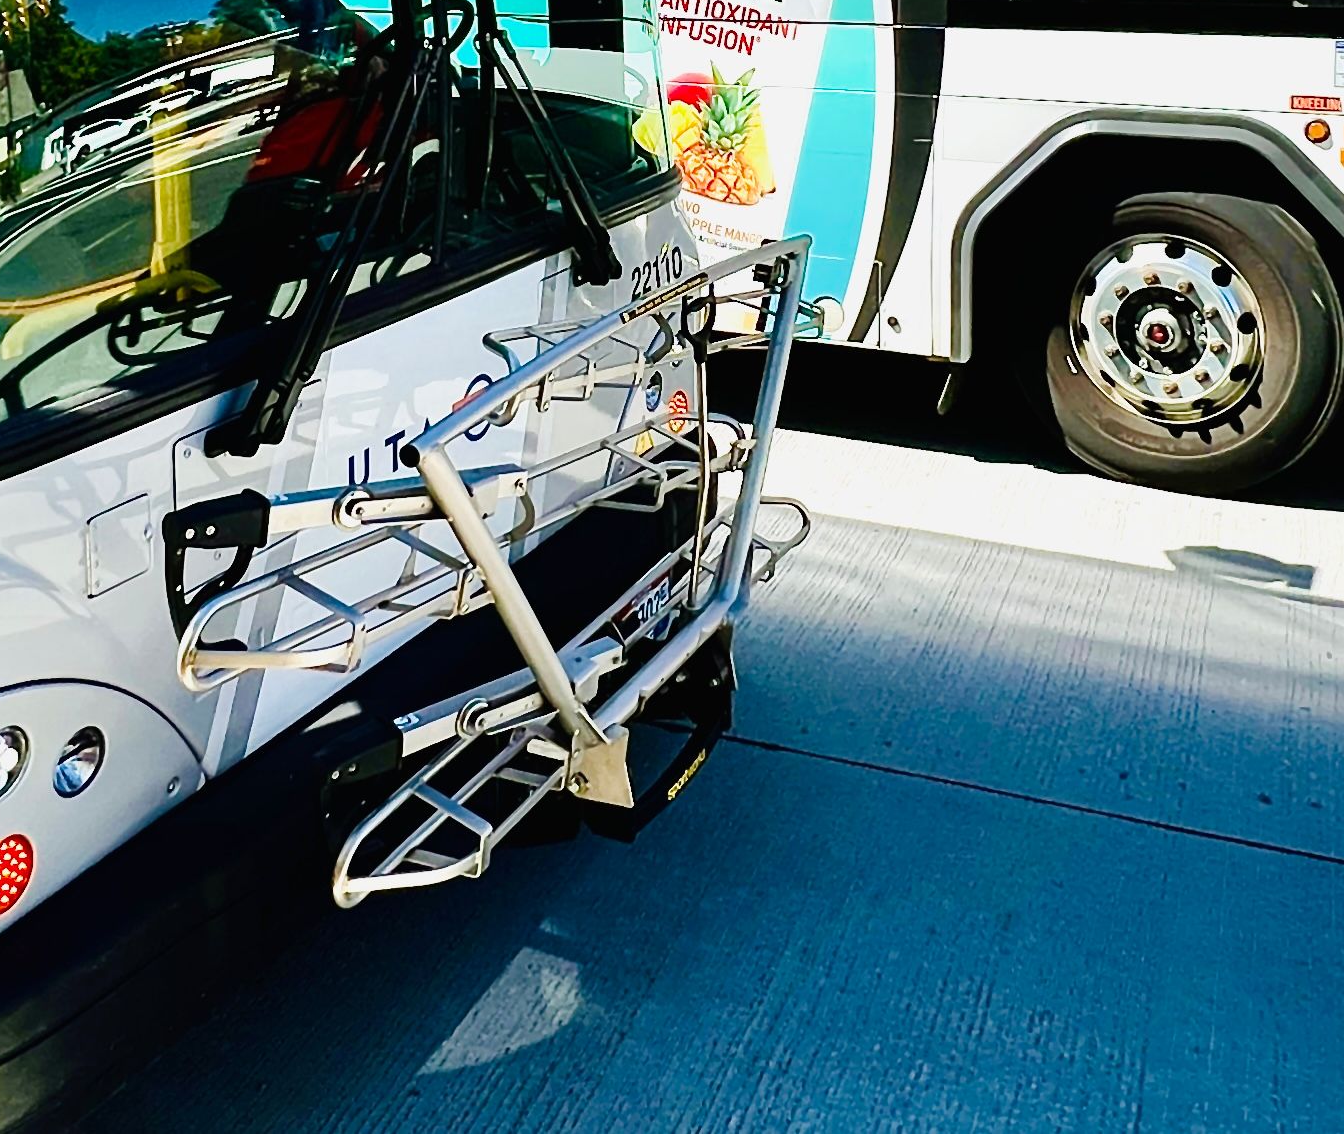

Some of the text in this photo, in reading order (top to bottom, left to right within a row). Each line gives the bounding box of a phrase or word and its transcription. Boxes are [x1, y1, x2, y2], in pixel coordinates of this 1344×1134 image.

[660, 15, 755, 56] NFUSION
[631, 246, 682, 303] 22110
[348, 417, 432, 487] UT
